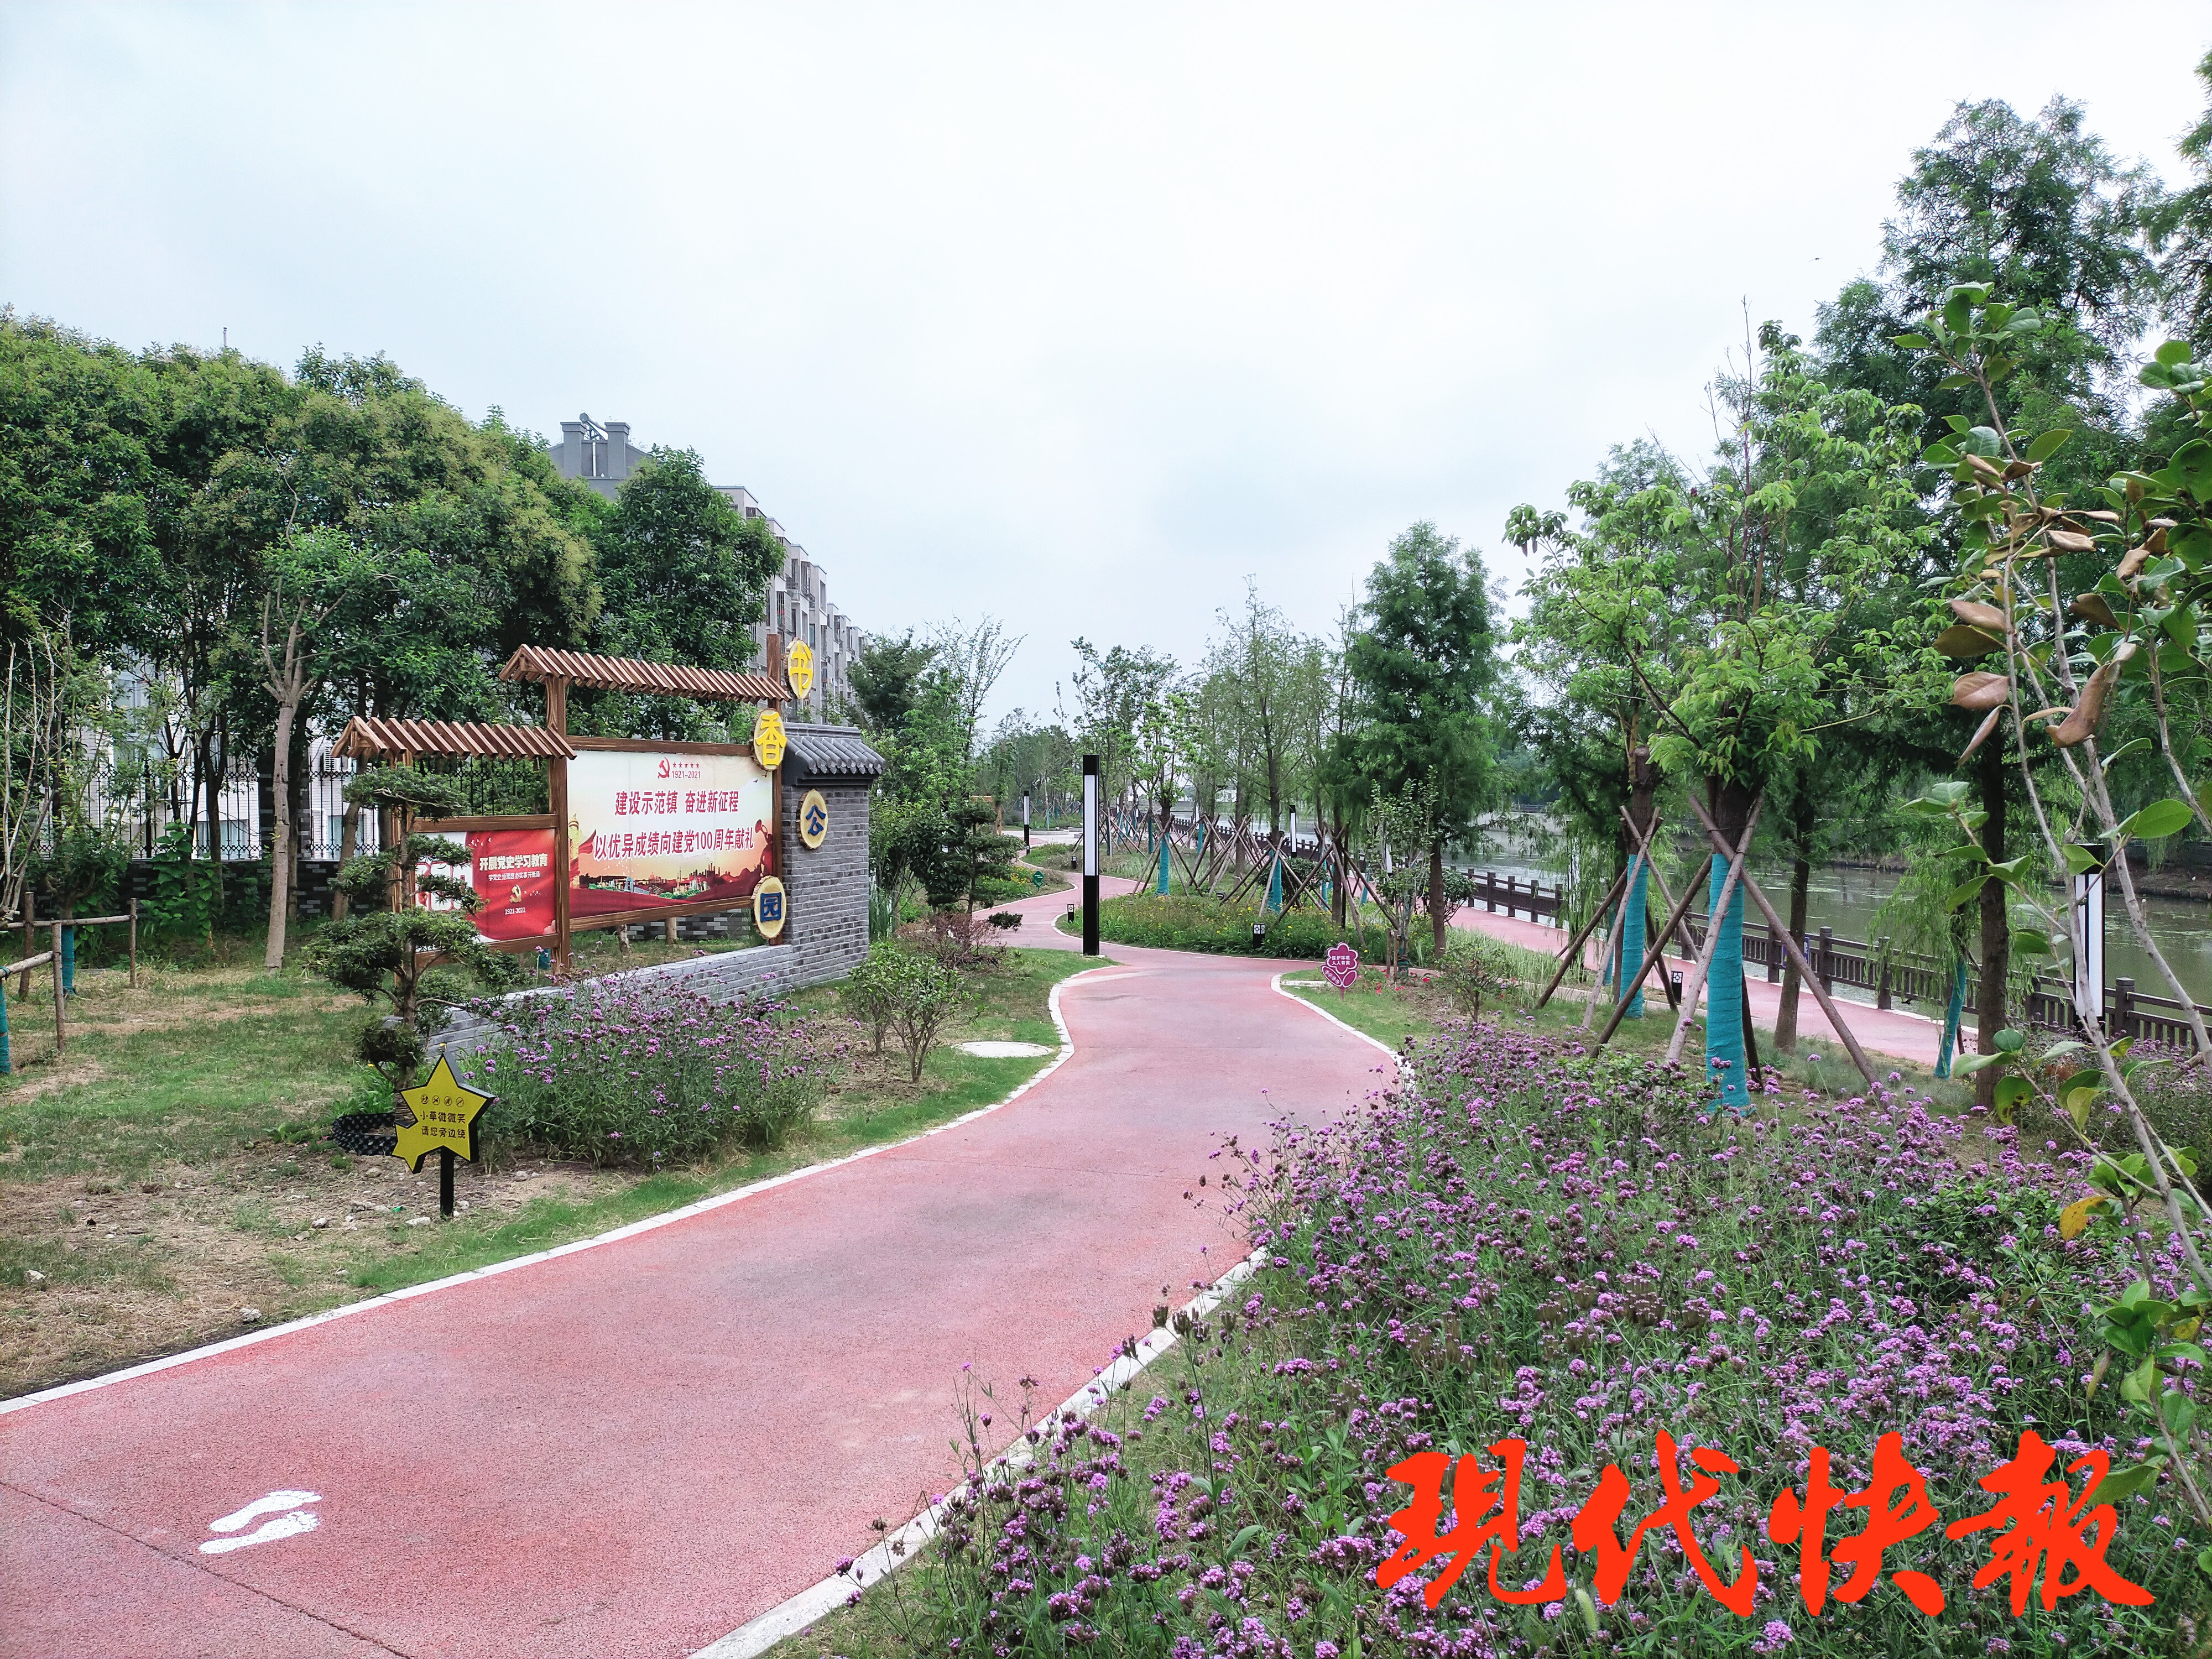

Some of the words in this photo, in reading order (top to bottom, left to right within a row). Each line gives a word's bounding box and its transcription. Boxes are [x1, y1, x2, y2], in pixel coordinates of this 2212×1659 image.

[789, 641, 812, 697] 书
[755, 711, 787, 766] 香
[671, 770, 701, 779] 1921-2021
[614, 790, 679, 816] 建设示范镇
[684, 790, 739, 814] 奋进新征程
[805, 804, 827, 836] 公
[593, 827, 754, 861] 以优异成绩向建党100周年献礼
[479, 853, 547, 871] 开展党史学习教育
[504, 907, 526, 915] 1921-2021
[760, 891, 782, 923] 园
[420, 1110, 466, 1124] 小草微微笑
[421, 1125, 466, 1139] 请您旁边绕
